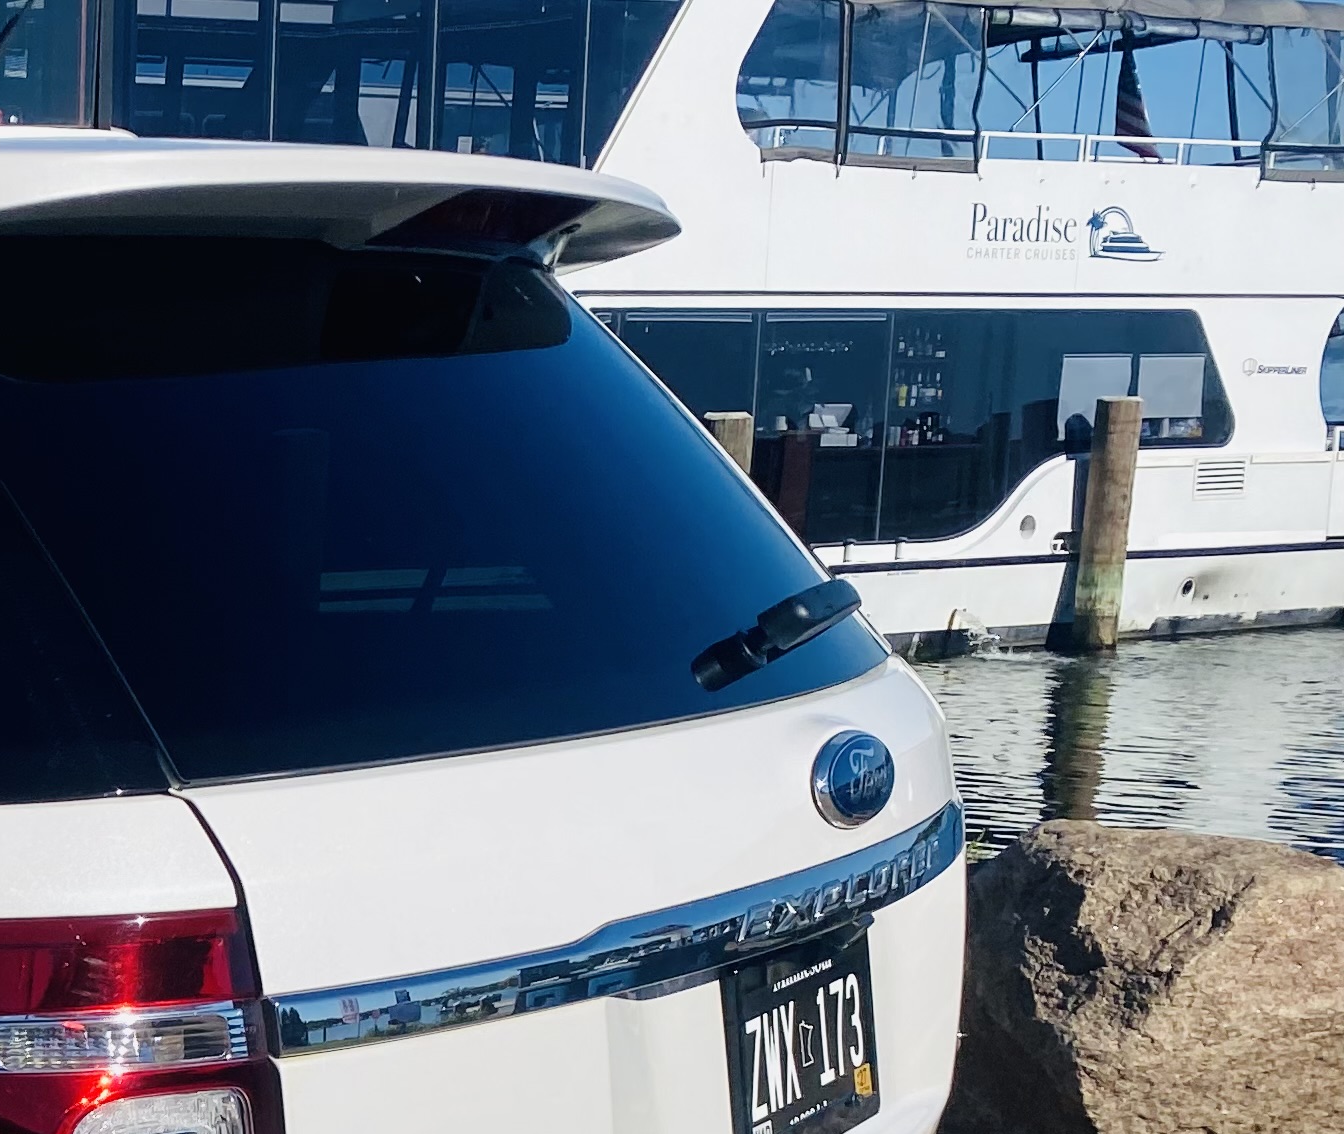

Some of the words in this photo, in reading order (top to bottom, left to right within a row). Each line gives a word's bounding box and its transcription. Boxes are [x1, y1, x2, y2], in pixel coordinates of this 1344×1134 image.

[966, 247, 1020, 260] CHARTER
[1025, 248, 1076, 261] CRUISES
[968, 202, 1077, 244] Paradise
[735, 832, 940, 943] EXPLORER
[744, 1000, 803, 1124] ZWX
[816, 973, 865, 1087] 173
